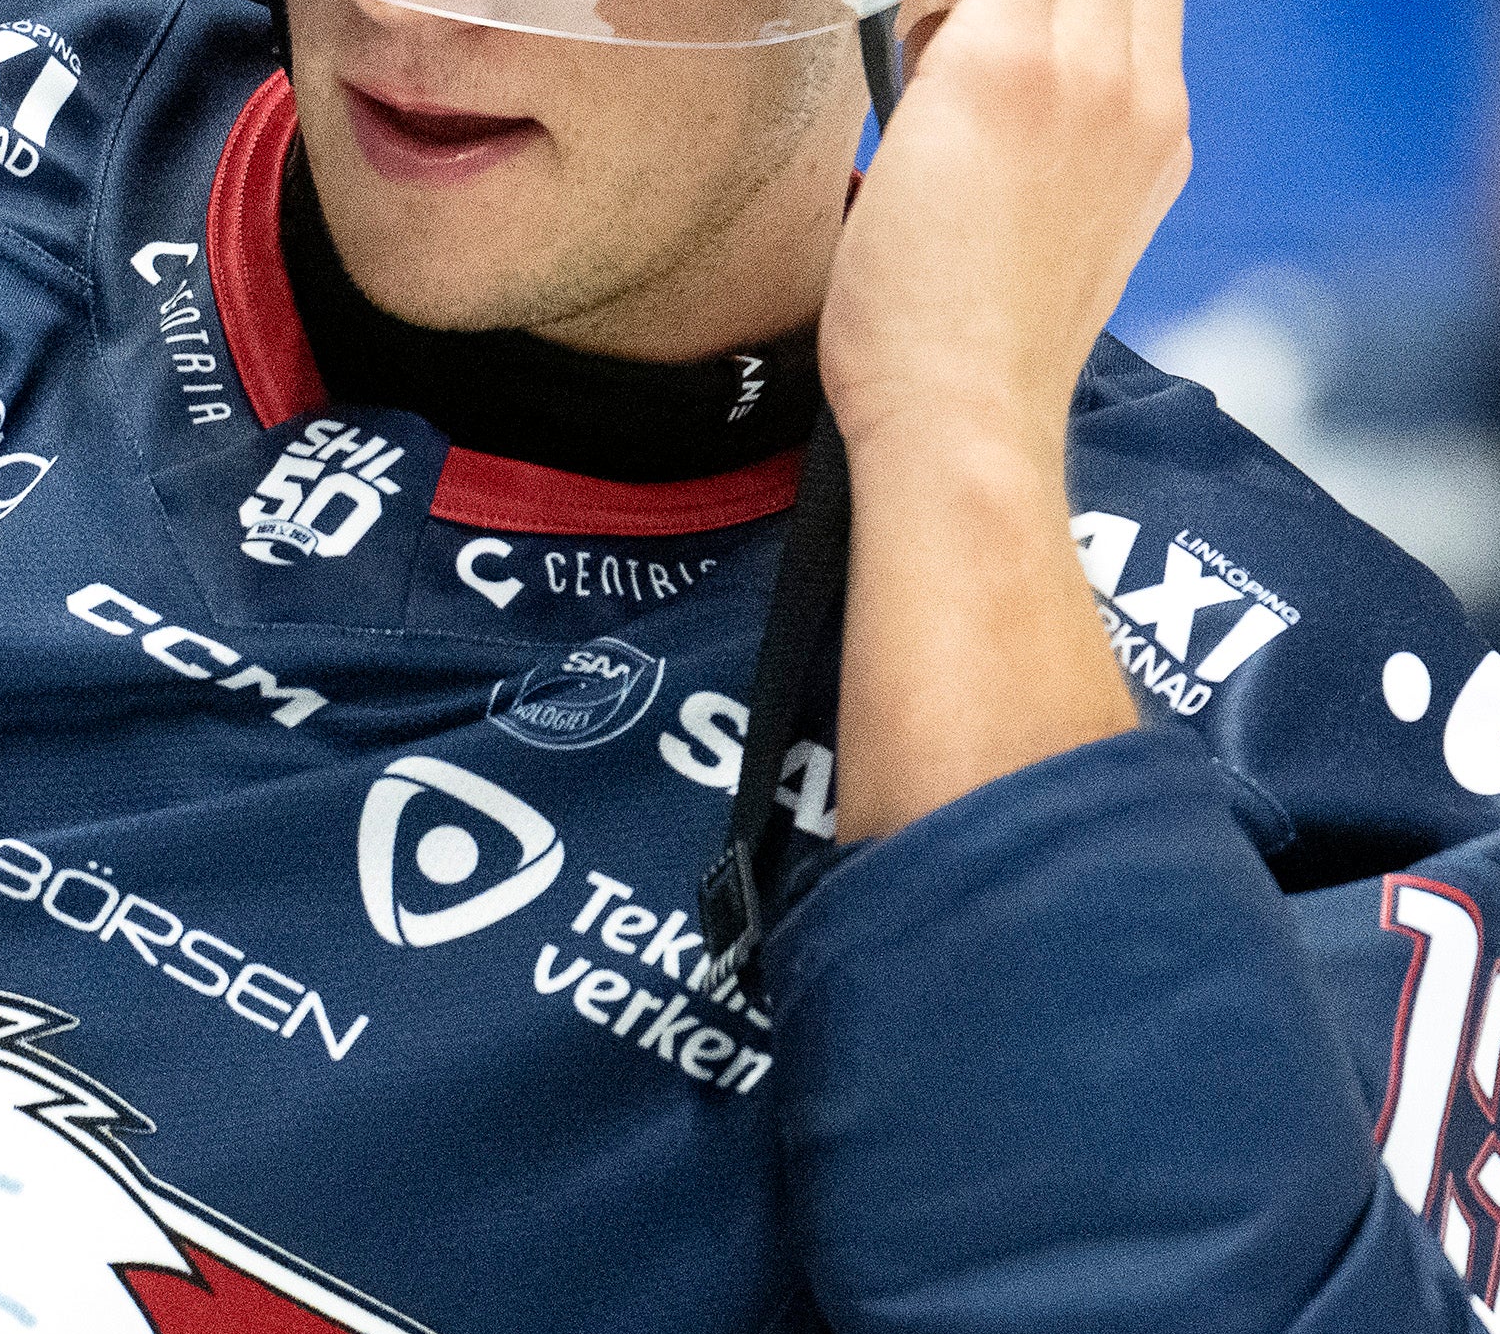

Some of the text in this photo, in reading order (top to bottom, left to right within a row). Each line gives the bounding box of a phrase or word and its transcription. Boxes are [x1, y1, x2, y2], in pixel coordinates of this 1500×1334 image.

[238, 453, 383, 565] 50
[285, 419, 405, 496] SHL
[1067, 510, 1290, 683] AXI
[1174, 529, 1301, 627] LINKÖPING
[66, 582, 330, 729] CCM
[534, 943, 773, 1095] verken
